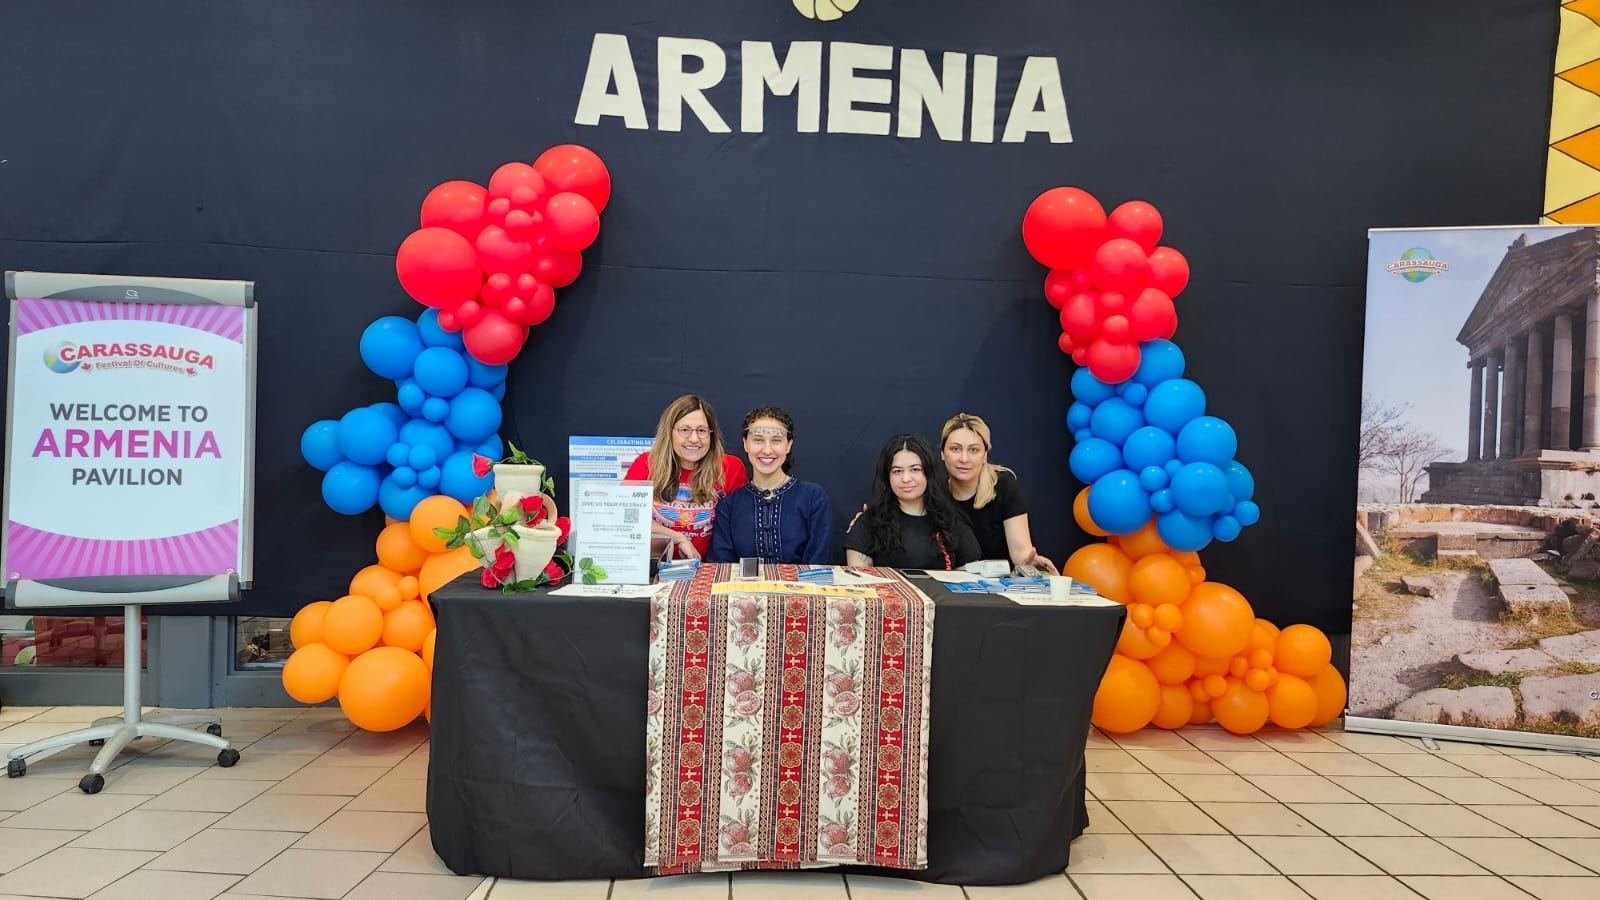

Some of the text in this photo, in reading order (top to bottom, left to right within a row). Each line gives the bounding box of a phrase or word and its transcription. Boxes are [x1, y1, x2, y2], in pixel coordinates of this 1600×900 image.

[574, 33, 1074, 144] ARMENIA
[60, 342, 214, 370] CARASSAUGA
[95, 359, 186, 374] Festival Of Cultures
[50, 403, 208, 423] WELCOME TO
[31, 428, 222, 459] ARMENIA
[72, 467, 183, 486] PAVILION
